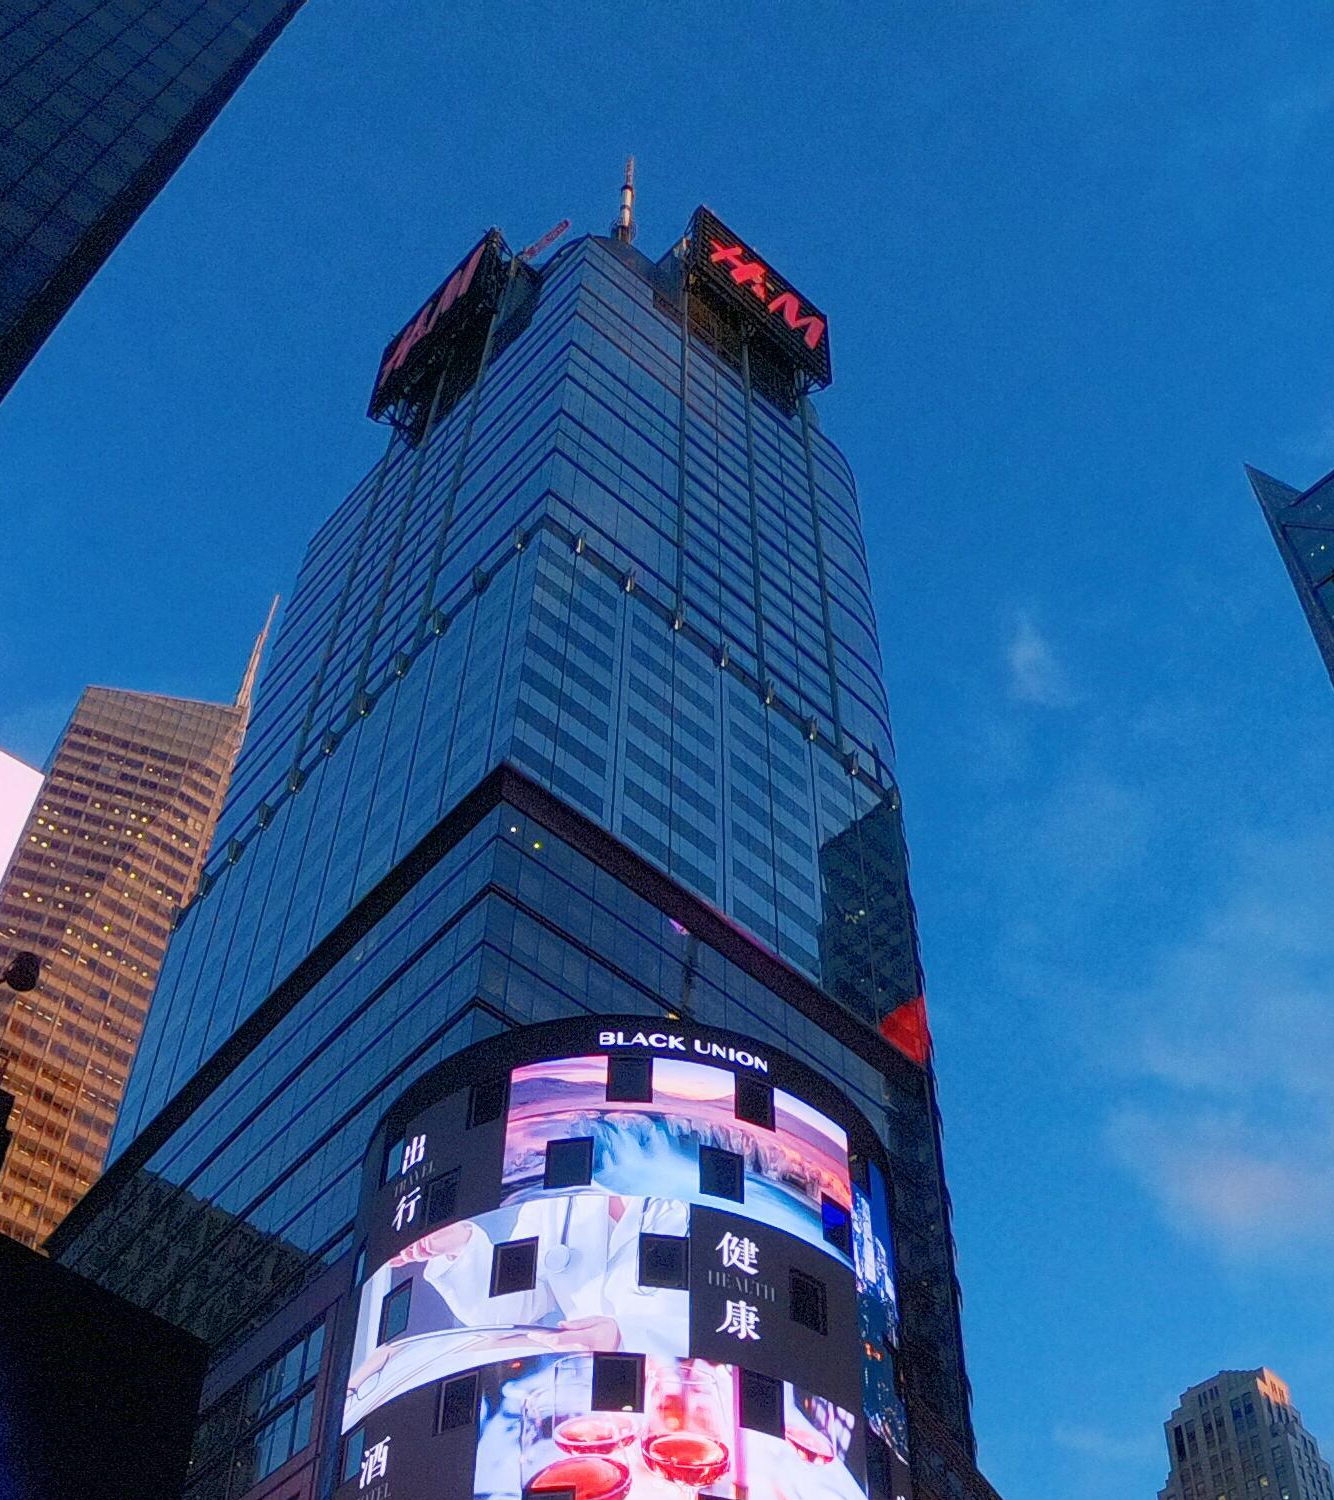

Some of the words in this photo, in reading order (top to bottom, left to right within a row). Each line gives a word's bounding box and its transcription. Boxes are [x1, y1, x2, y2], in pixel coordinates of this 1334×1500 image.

[599, 1031, 687, 1051] BLACK
[693, 1039, 768, 1073] UNION
[391, 1134, 427, 1231] 出行
[715, 1231, 761, 1341] 健康
